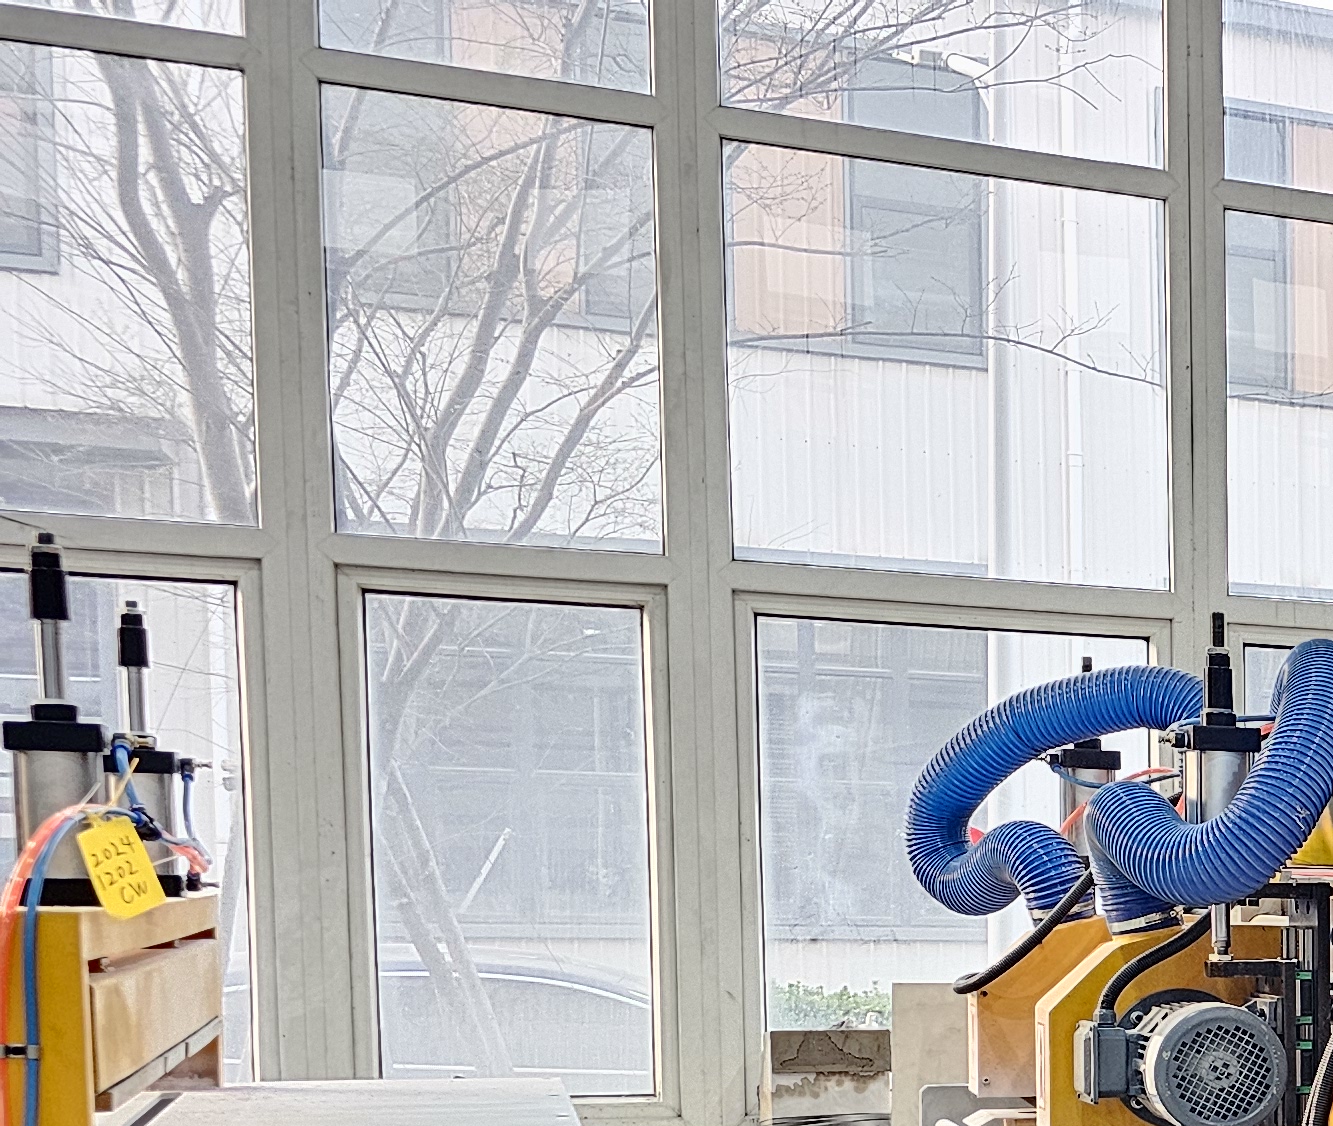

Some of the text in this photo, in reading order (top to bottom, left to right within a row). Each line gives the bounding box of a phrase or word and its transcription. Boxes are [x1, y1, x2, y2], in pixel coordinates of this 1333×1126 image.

[90, 835, 135, 868] 2024
[96, 860, 139, 891] 1202
[120, 880, 148, 904] CW
